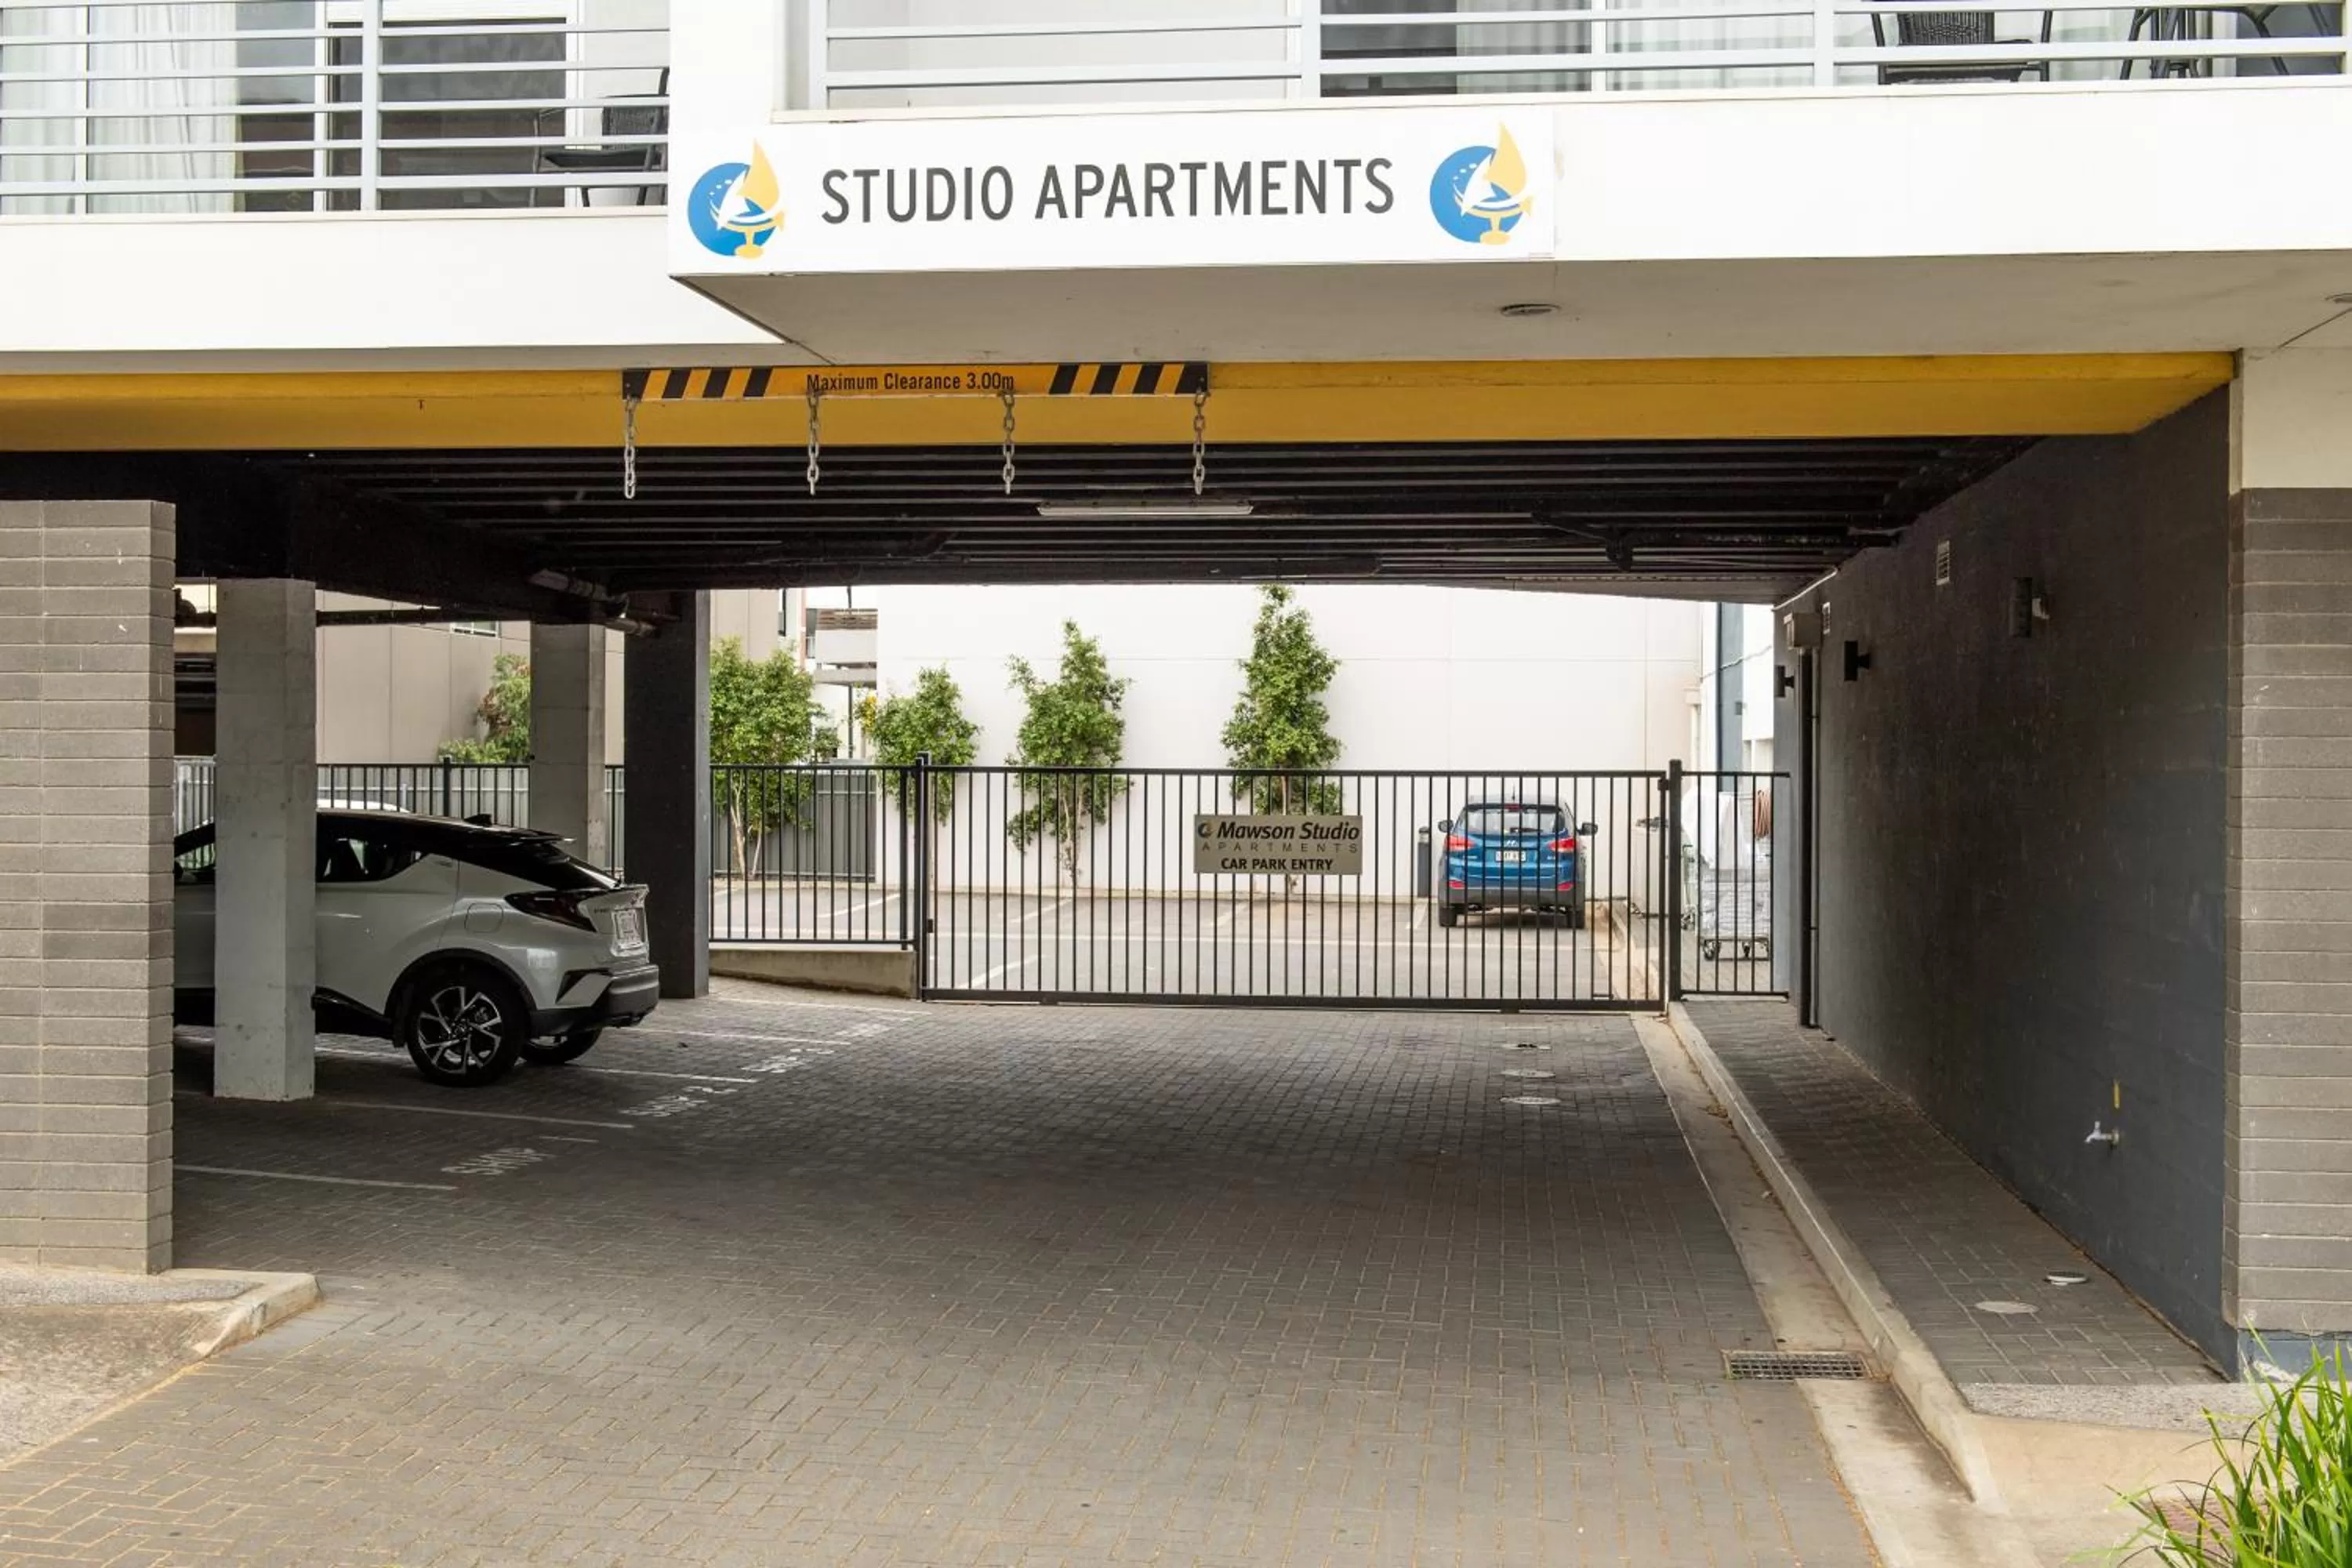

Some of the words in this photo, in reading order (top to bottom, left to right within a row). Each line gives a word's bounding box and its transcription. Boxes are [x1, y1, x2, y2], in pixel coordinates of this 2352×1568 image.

[822, 165, 1014, 224] STUDIO
[1035, 158, 1394, 220] APARTMENTS
[806, 374, 878, 391] Maximum
[884, 372, 960, 390] Clearance
[966, 372, 1014, 390] 3.00m
[1217, 821, 1295, 840] Mawson
[1299, 821, 1360, 840] Studio
[1202, 842, 1358, 853] APARTMENTS
[1221, 858, 1247, 869] CAR
[1252, 858, 1287, 870] PARK
[1291, 859, 1334, 871] ENTRY
[440, 1147, 558, 1175] SHOP
